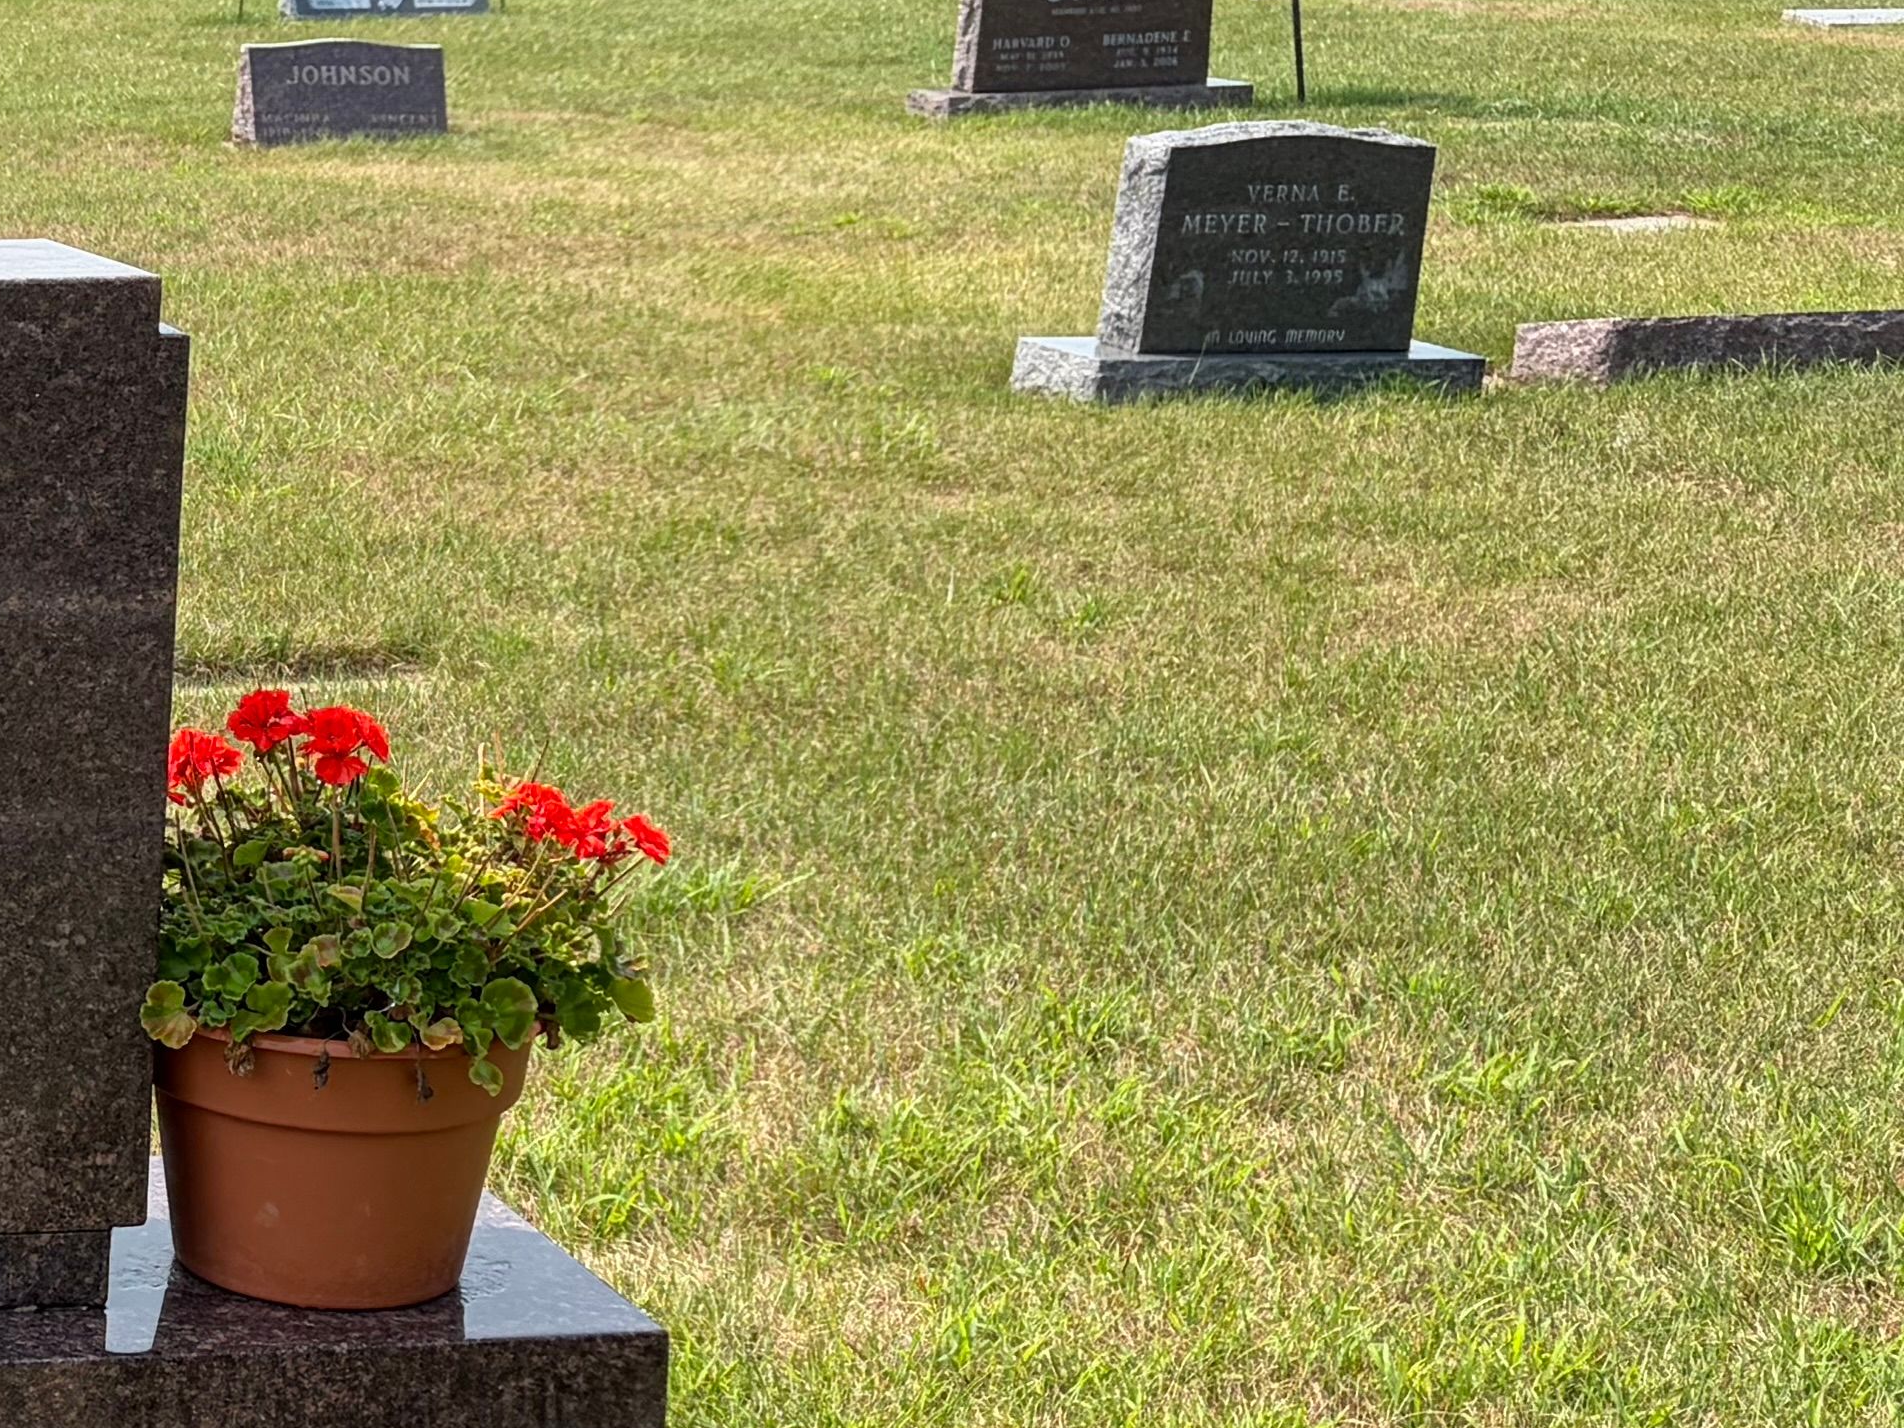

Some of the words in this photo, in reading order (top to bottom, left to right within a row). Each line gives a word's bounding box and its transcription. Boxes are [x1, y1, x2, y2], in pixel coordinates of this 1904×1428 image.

[992, 36, 1055, 51] HARVARD
[1103, 31, 1178, 46] BERNADENE
[286, 65, 411, 85] JOHNSON
[1248, 184, 1320, 203] VERNA
[1338, 184, 1355, 202] E.
[1181, 214, 1267, 235] MEYER
[1300, 213, 1406, 236] THOBER
[1227, 270, 1273, 285] JULY
[1305, 269, 1344, 285] 1995
[1229, 329, 1276, 345] LOVING
[1285, 329, 1346, 343] MEMORY
